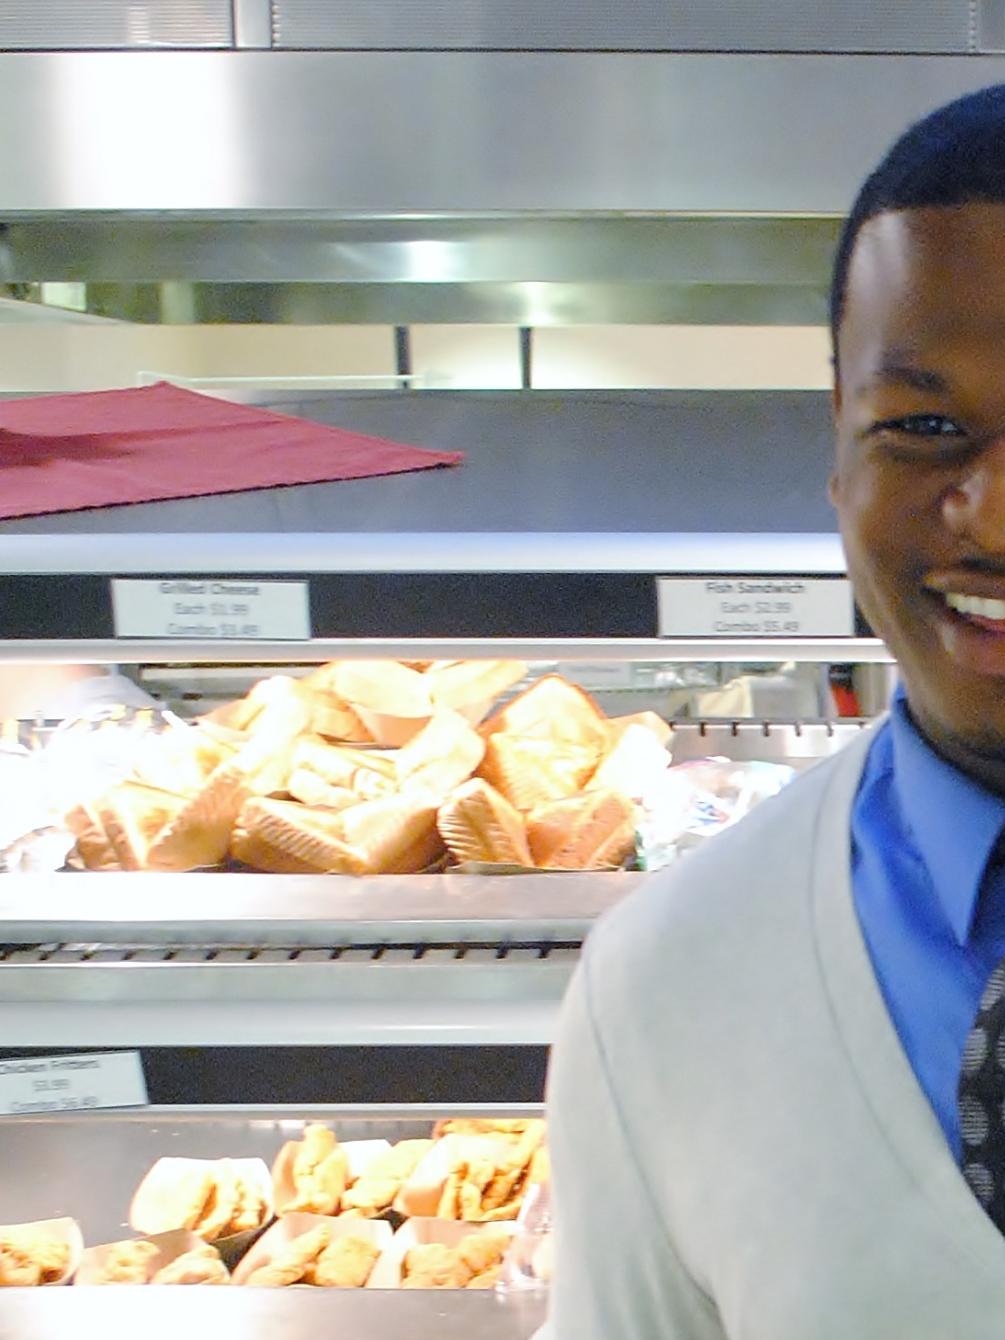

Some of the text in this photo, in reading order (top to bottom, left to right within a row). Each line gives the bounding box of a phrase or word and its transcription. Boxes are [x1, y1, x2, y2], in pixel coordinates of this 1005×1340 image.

[160, 582, 260, 595] Grilled Cheese
[707, 581, 805, 593] Fish Sandwich
[721, 602, 750, 613] Each
[714, 621, 759, 632] Combo
